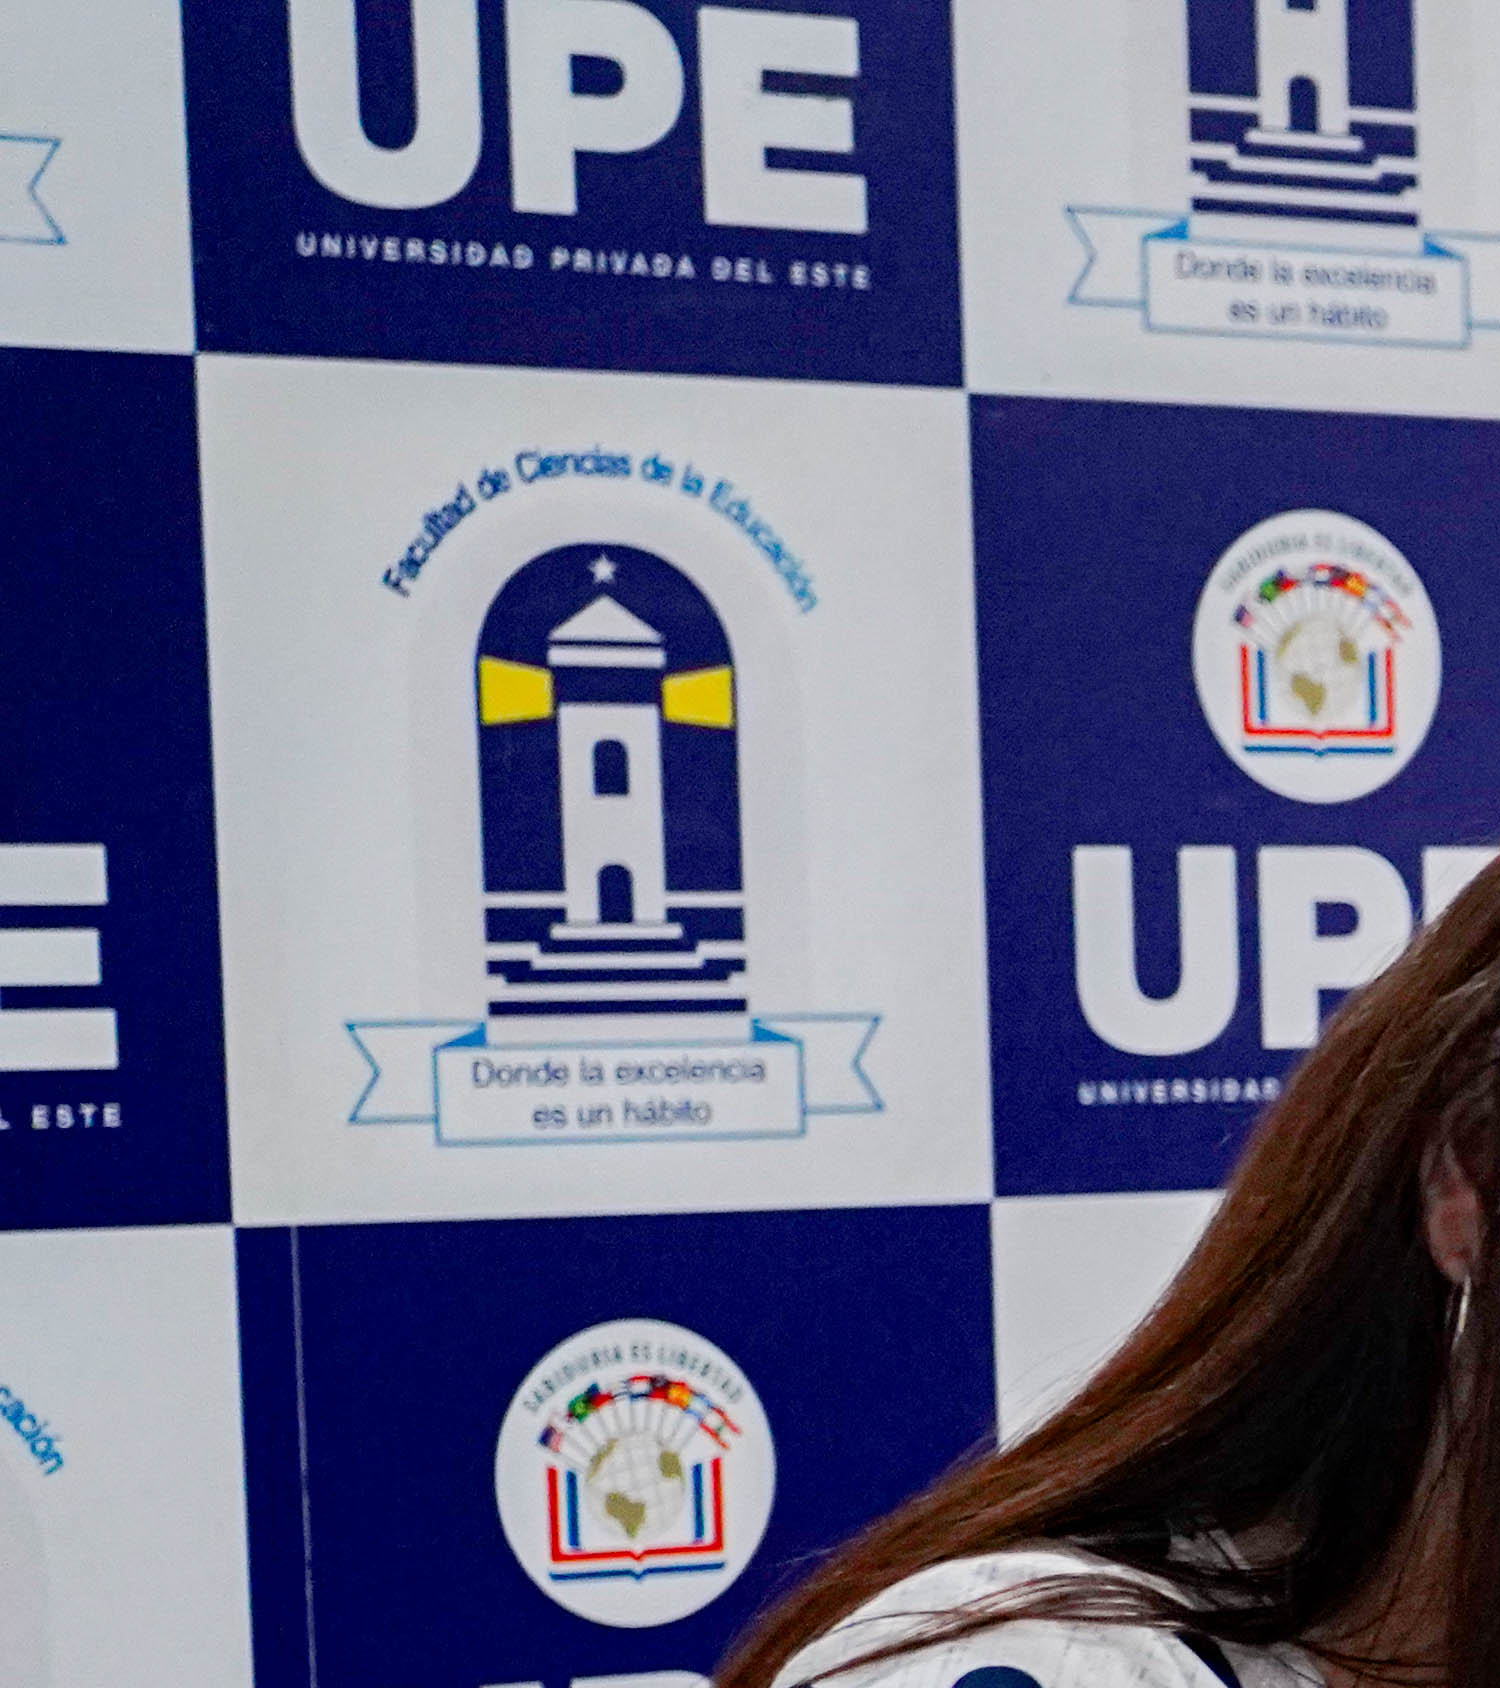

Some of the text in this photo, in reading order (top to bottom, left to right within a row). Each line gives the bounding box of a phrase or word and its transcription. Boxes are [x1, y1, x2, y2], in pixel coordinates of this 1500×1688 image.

[288, 0, 868, 234] UPE
[296, 232, 871, 290] UNIVERSIDAD PRIVADA DEL ESTE
[382, 444, 818, 615] Facultad de Ciencias de la Educación
[471, 1054, 767, 1088] Donde la excelencia
[32, 1103, 122, 1129] ESTE
[532, 1097, 713, 1129] es un hábito
